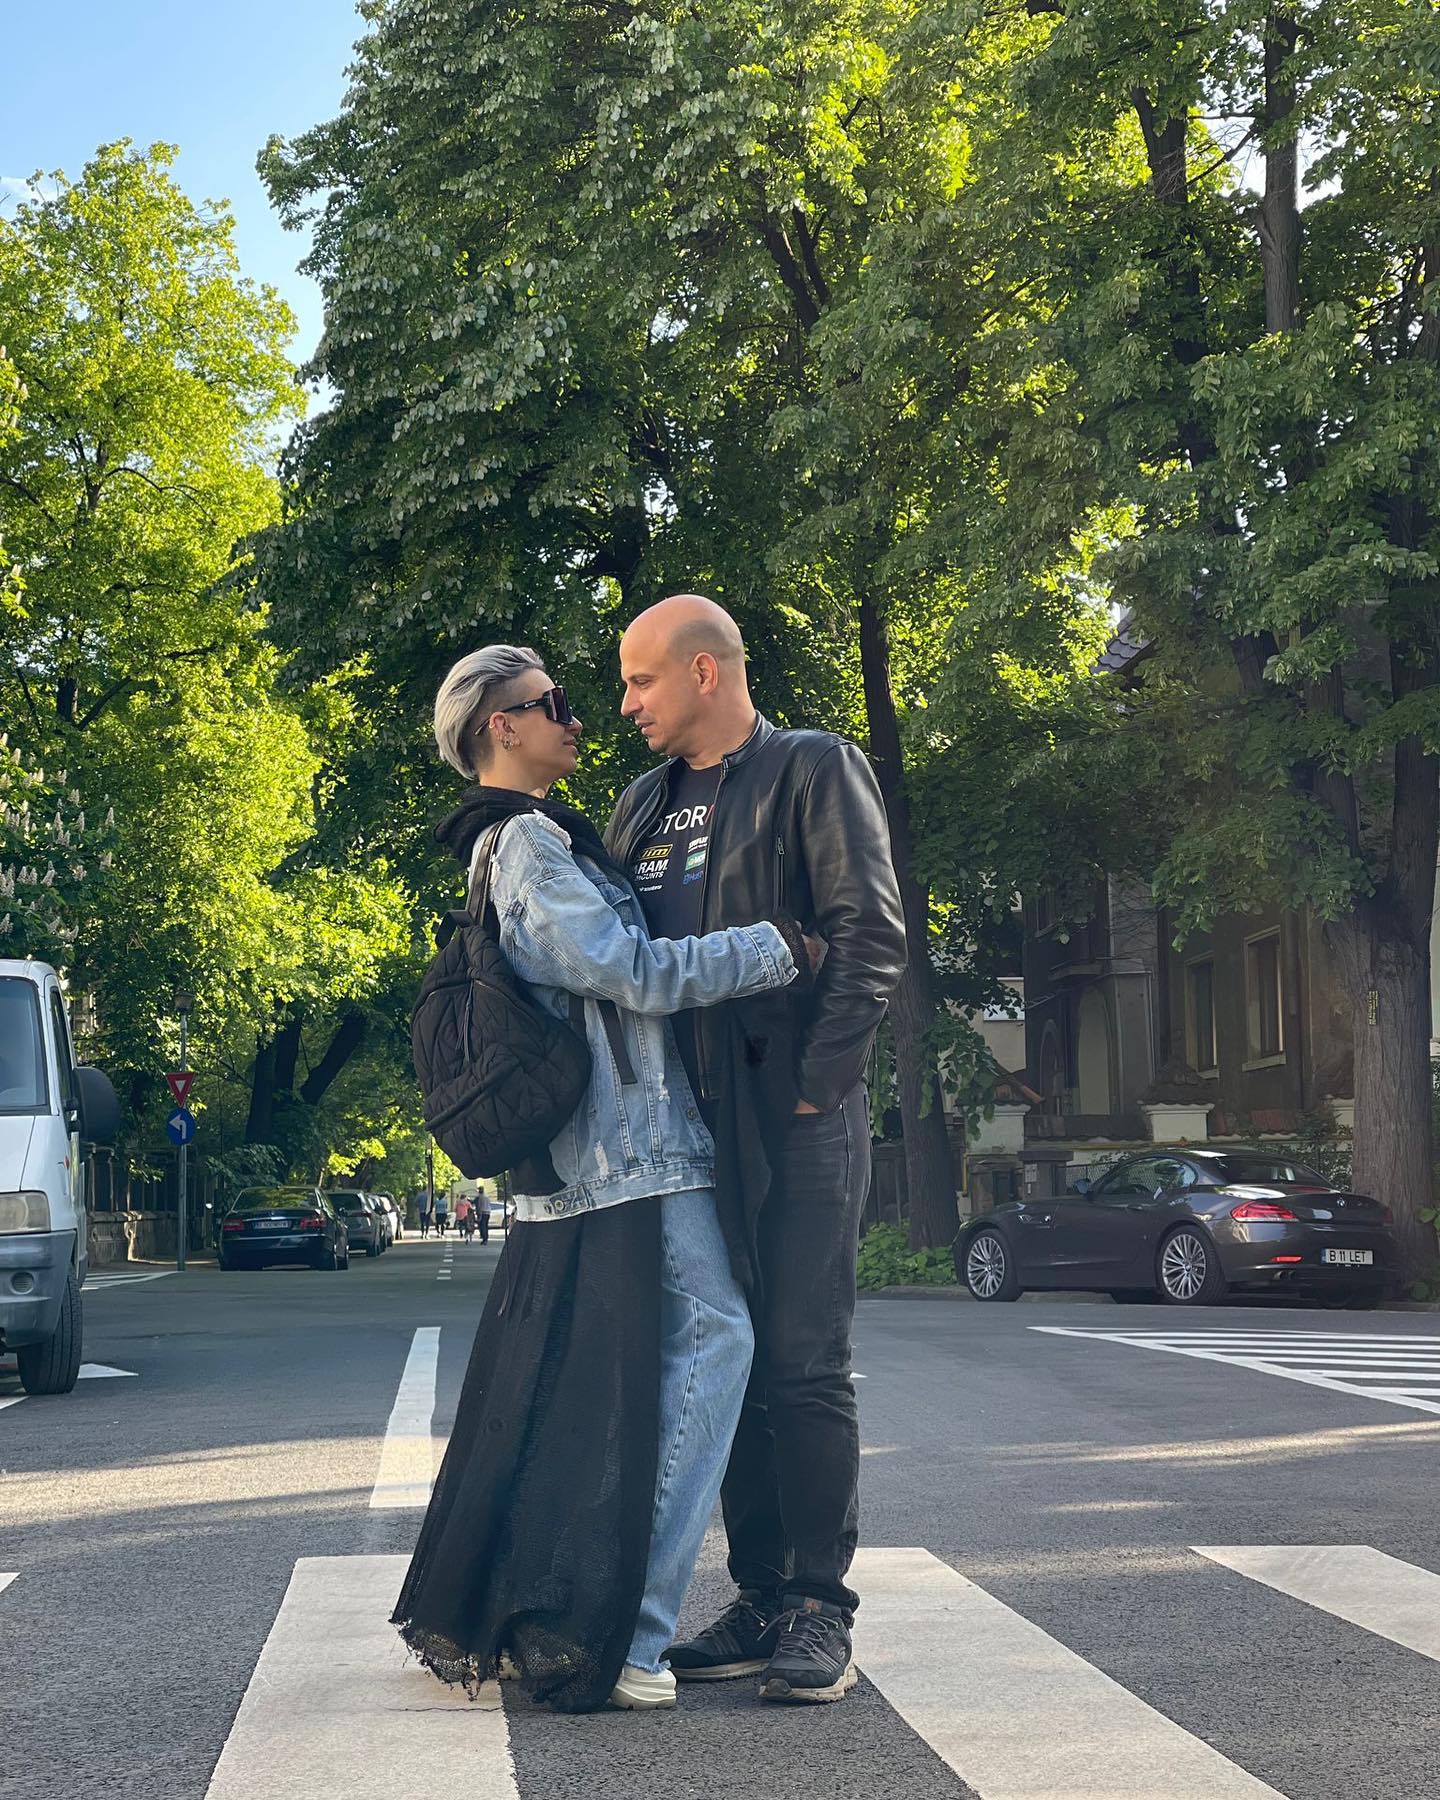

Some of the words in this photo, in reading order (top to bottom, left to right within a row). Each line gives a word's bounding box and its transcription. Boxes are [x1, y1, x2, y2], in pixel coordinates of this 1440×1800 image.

[637, 859, 669, 875] RAM
[1330, 1250, 1336, 1261] B
[1340, 1251, 1345, 1261] 11
[1350, 1251, 1365, 1262] LET
